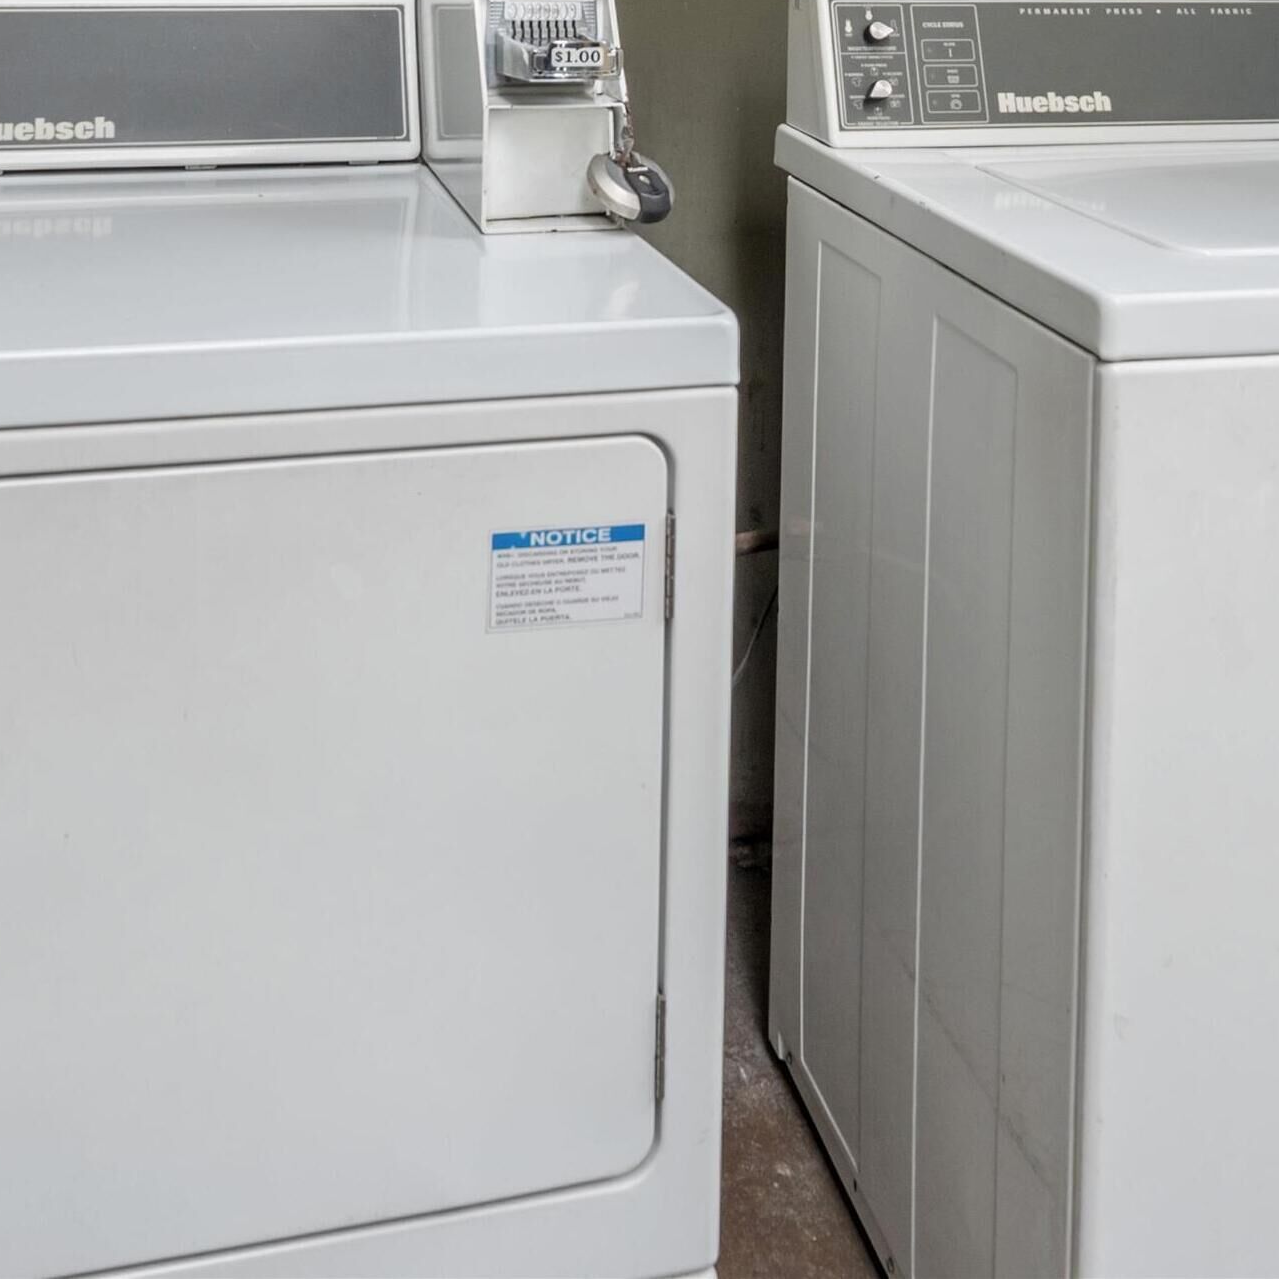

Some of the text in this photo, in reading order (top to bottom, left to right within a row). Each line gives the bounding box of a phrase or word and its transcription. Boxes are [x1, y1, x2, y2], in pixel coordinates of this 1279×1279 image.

[555, 50, 601, 63] $1.00
[997, 91, 1112, 114] Huebsch
[530, 528, 611, 546] NOTICE
